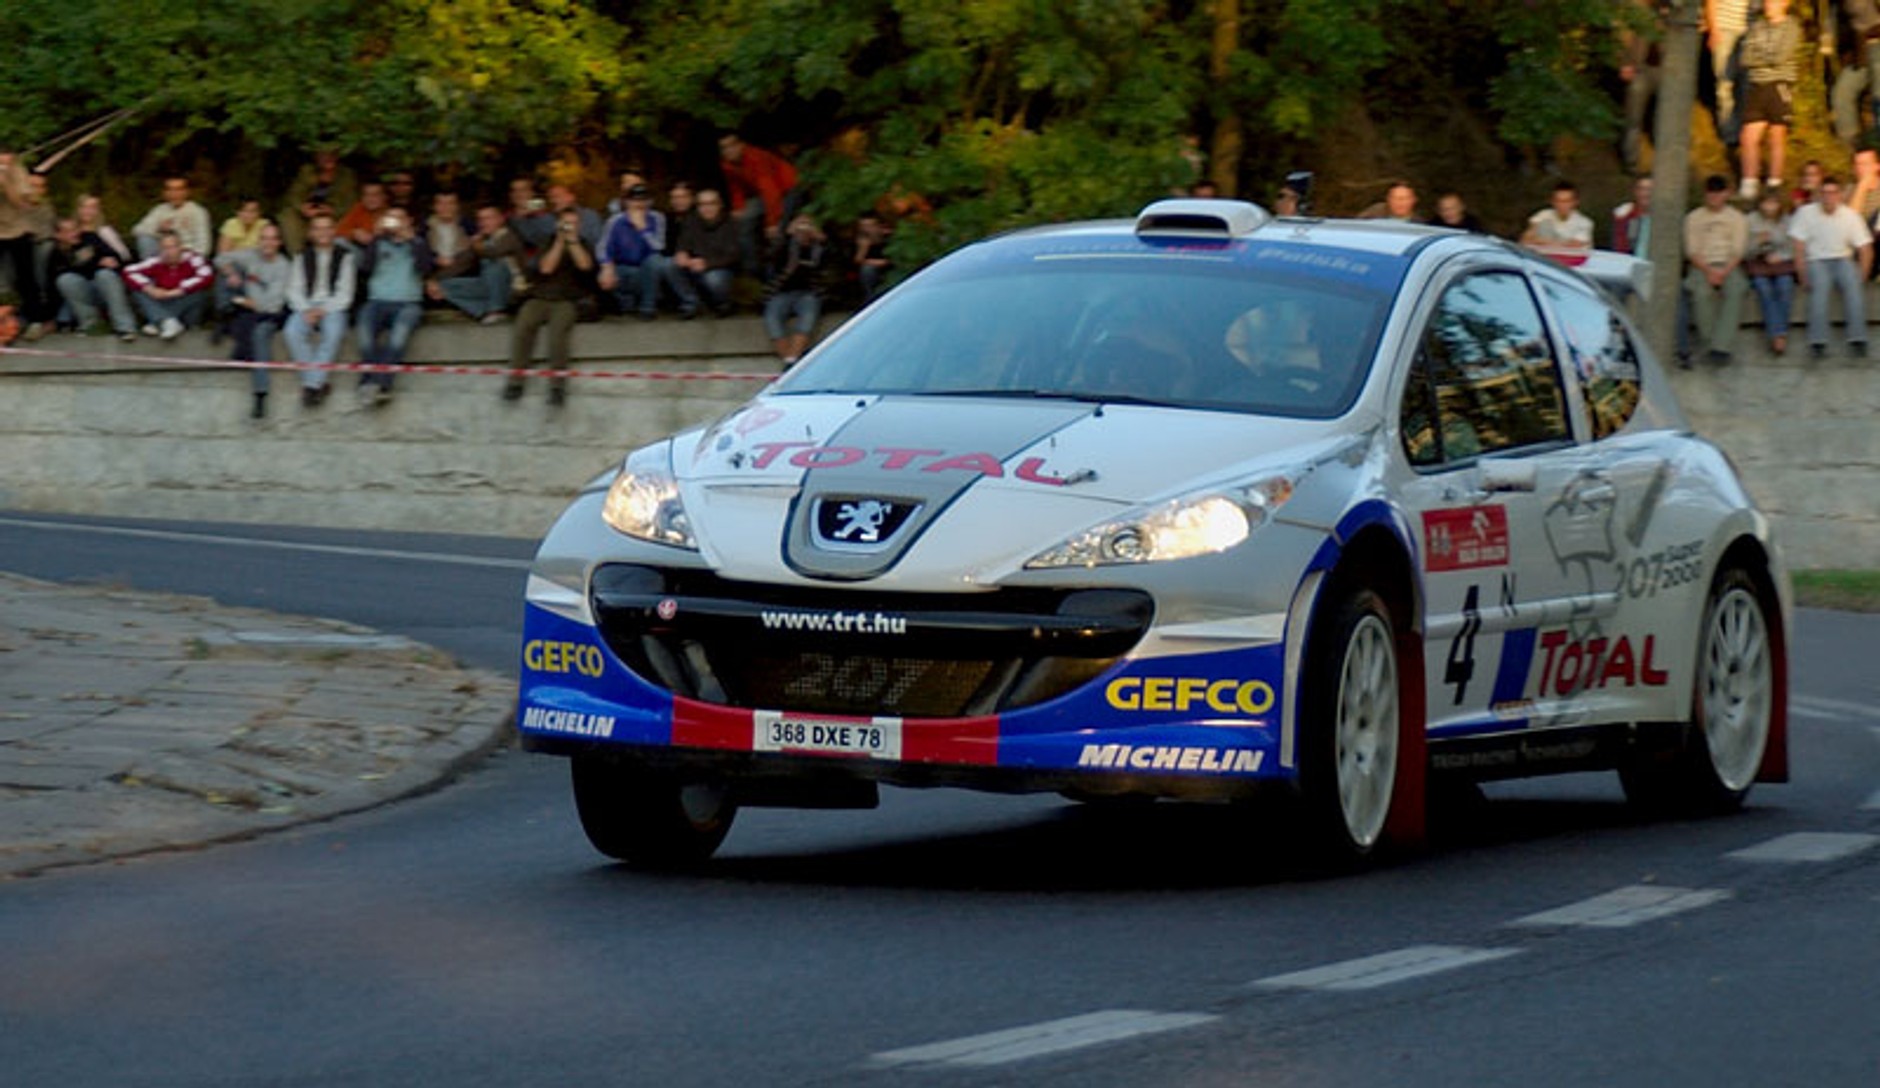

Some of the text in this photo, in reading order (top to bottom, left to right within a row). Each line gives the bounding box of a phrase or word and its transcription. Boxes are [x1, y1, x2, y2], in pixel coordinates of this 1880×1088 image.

[751, 440, 1069, 486] TOTAL
[761, 610, 907, 634] www.trt.hu
[524, 639, 604, 678] GEFCO
[1444, 584, 1481, 705] 4
[1537, 629, 1669, 698] TOTAL
[1105, 676, 1275, 714] GEFCO
[523, 706, 616, 738] MICHELIN
[772, 722, 882, 749] 368 DXE 78
[1078, 744, 1265, 772] MICHELIN
